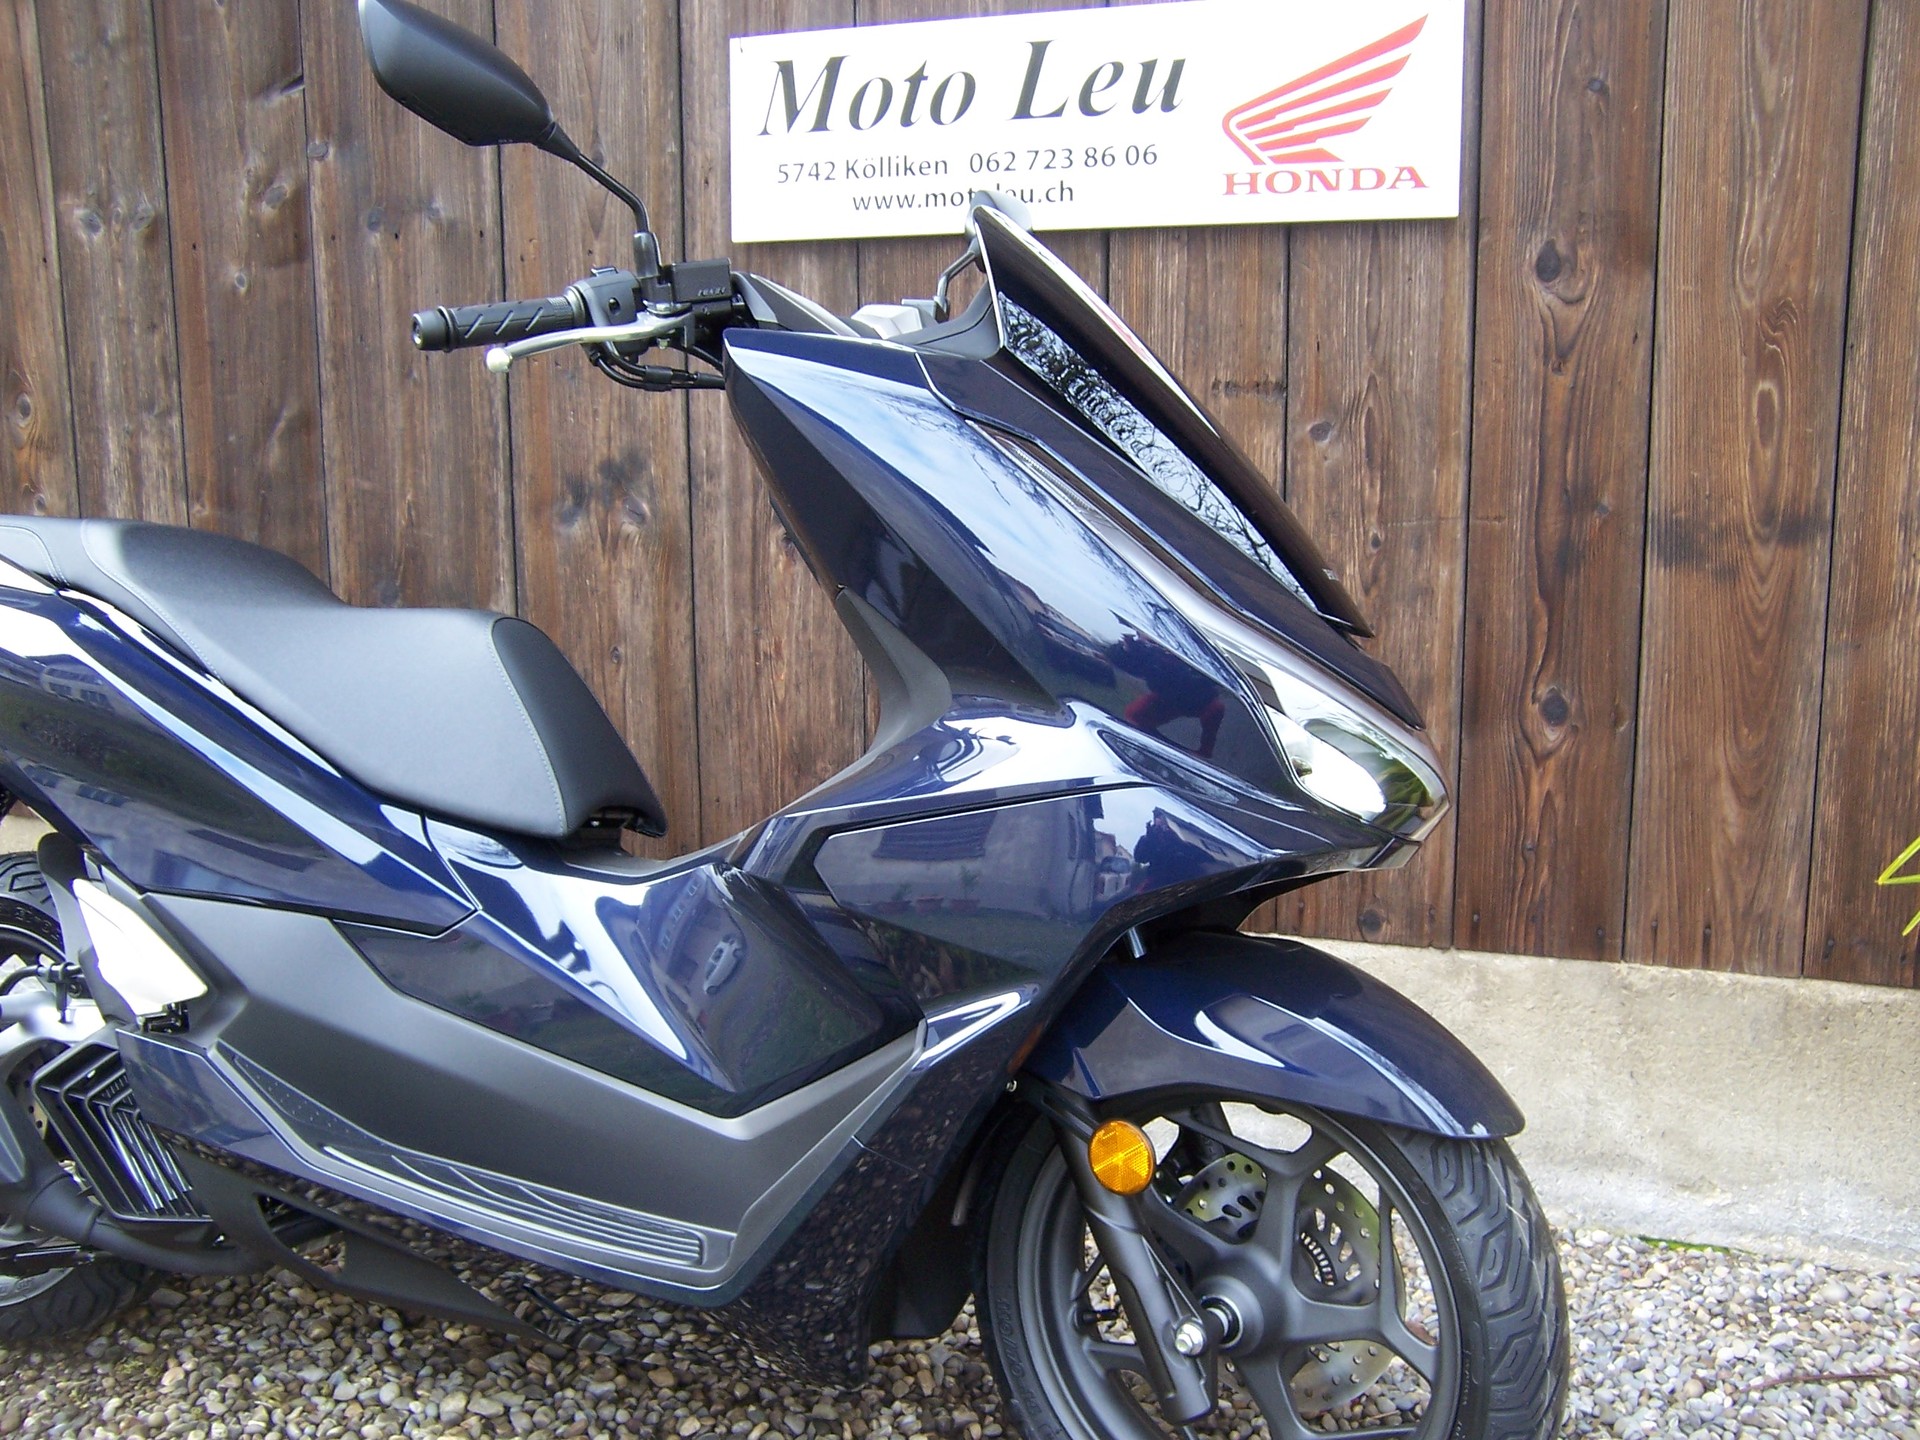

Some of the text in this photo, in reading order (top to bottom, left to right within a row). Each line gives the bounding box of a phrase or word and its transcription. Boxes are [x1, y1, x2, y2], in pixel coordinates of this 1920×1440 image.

[757, 39, 1186, 136] Moto Leu
[778, 144, 1158, 184] 5742 Kölliken 062 723 86 06
[1222, 166, 1429, 196] HONDA
